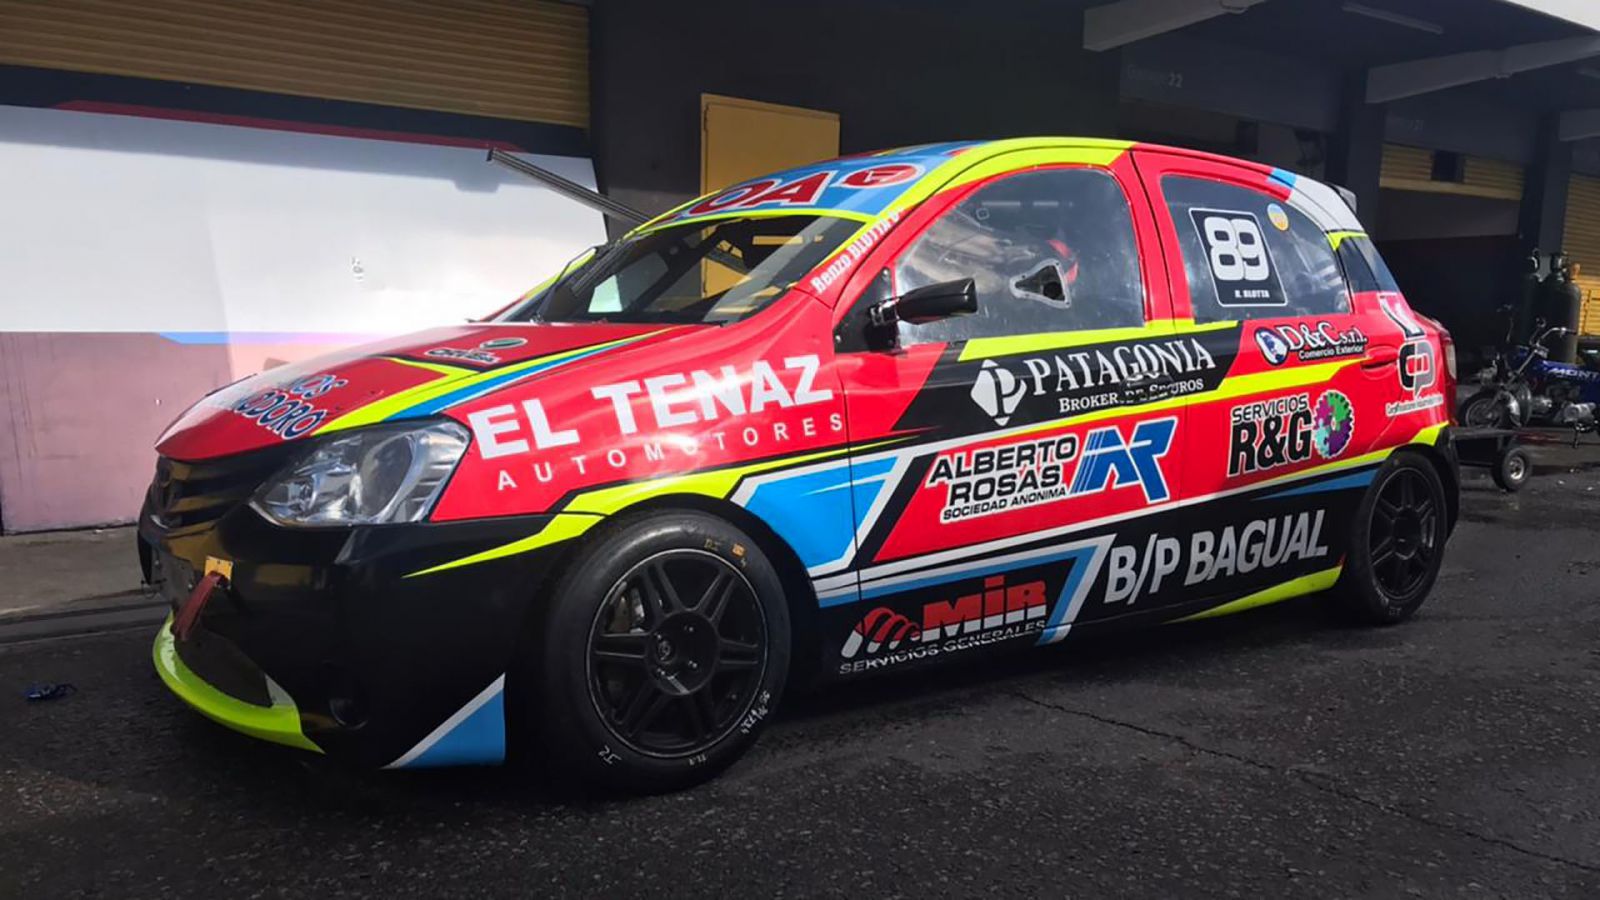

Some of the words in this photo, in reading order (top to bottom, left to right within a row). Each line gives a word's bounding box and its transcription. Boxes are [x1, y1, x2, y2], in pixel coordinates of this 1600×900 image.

[1167, 71, 1184, 89] 22
[1204, 216, 1270, 281] 89
[1024, 338, 1217, 395] PATAGONIA
[1299, 347, 1335, 359] Comercio
[1335, 344, 1364, 355] Exterior
[466, 396, 580, 460] EL
[590, 353, 834, 436] TENAZ
[1059, 392, 1119, 414] BROKER
[1231, 394, 1309, 423] SERVICIOS
[496, 412, 844, 492] AUTOMOTORES
[929, 435, 1077, 484] ALBERTO
[1228, 413, 1313, 477] R&G
[943, 500, 1008, 520] SOCIEDAD
[1010, 487, 1067, 507] ANONIMA
[949, 465, 1062, 506] ROSAS
[1103, 532, 1181, 606] B/P
[1184, 509, 1329, 586] BAGUAL
[839, 643, 939, 675] SERVICIOS
[943, 620, 1046, 652] GENERALES
